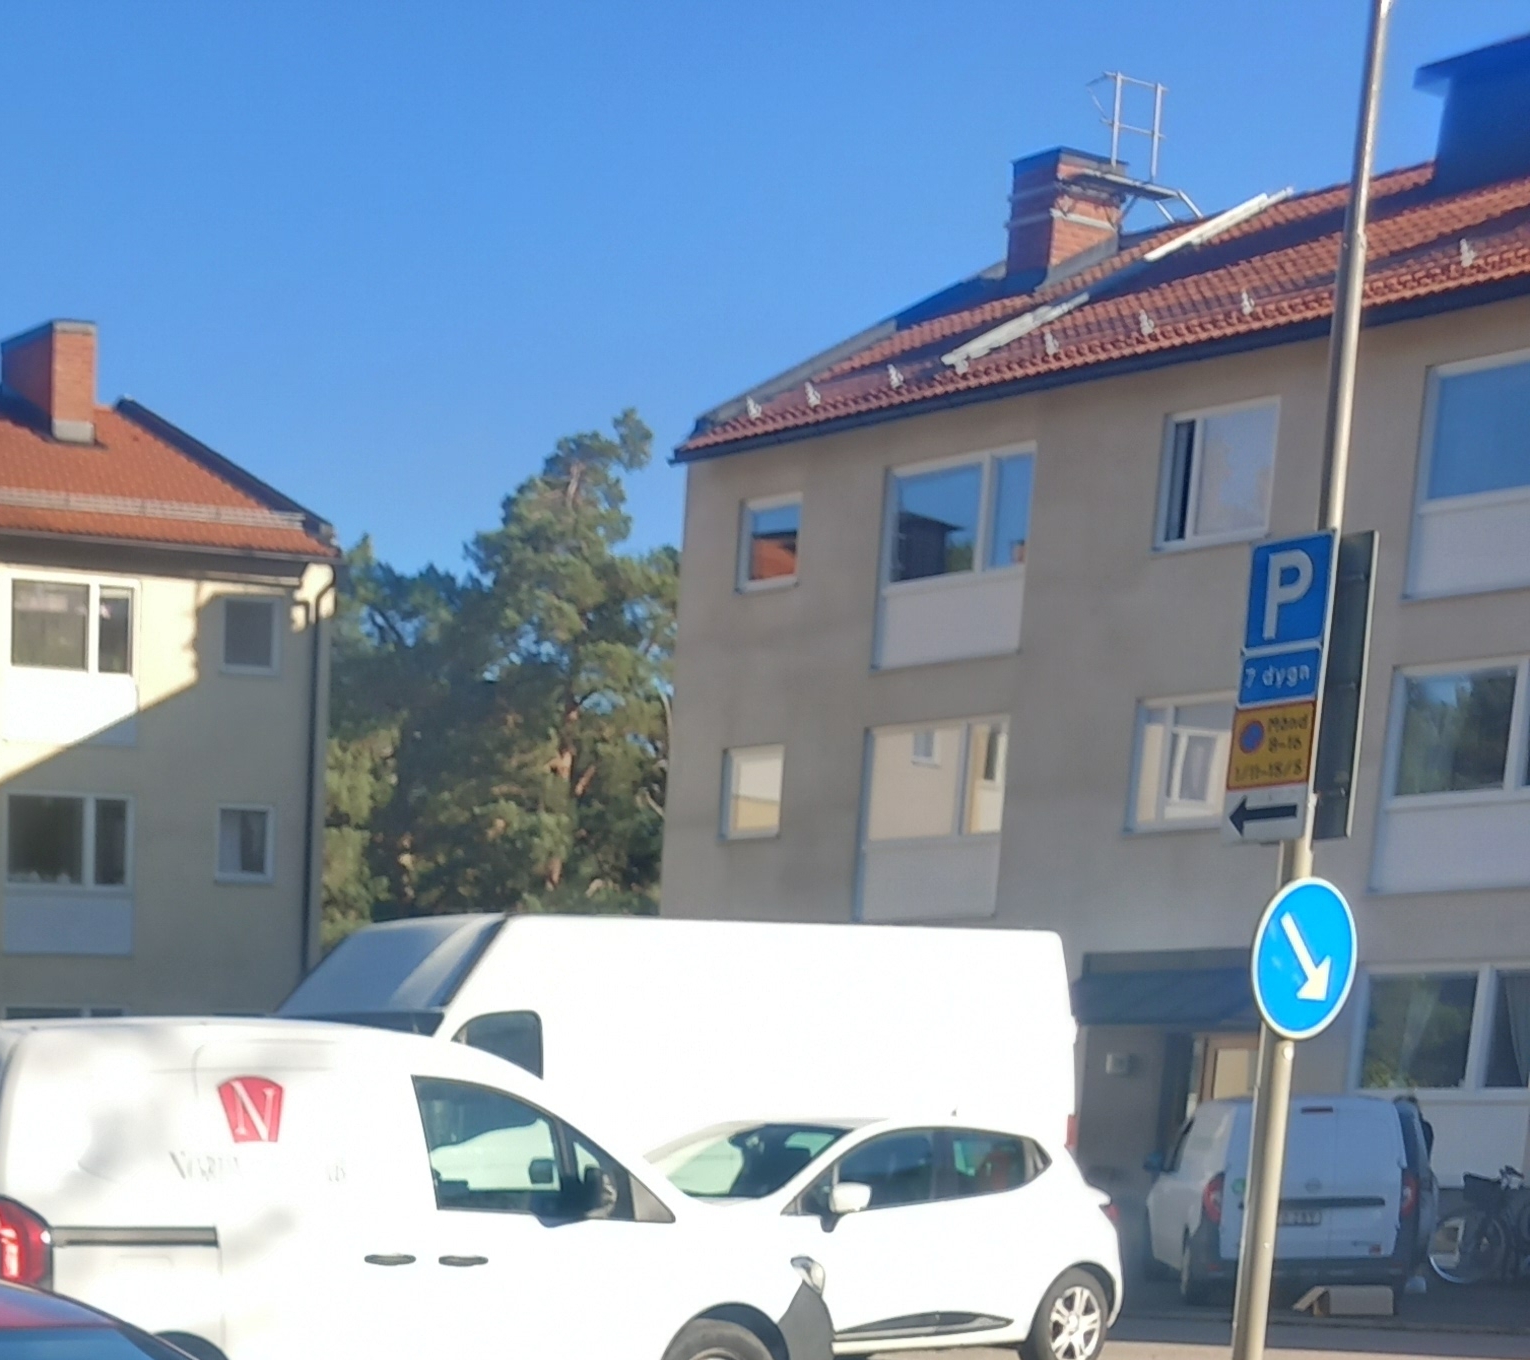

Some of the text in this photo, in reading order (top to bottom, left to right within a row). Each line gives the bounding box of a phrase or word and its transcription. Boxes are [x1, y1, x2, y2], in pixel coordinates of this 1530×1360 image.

[1263, 548, 1314, 640] P
[1245, 664, 1310, 689] 7 dygn
[229, 1080, 276, 1141] N
